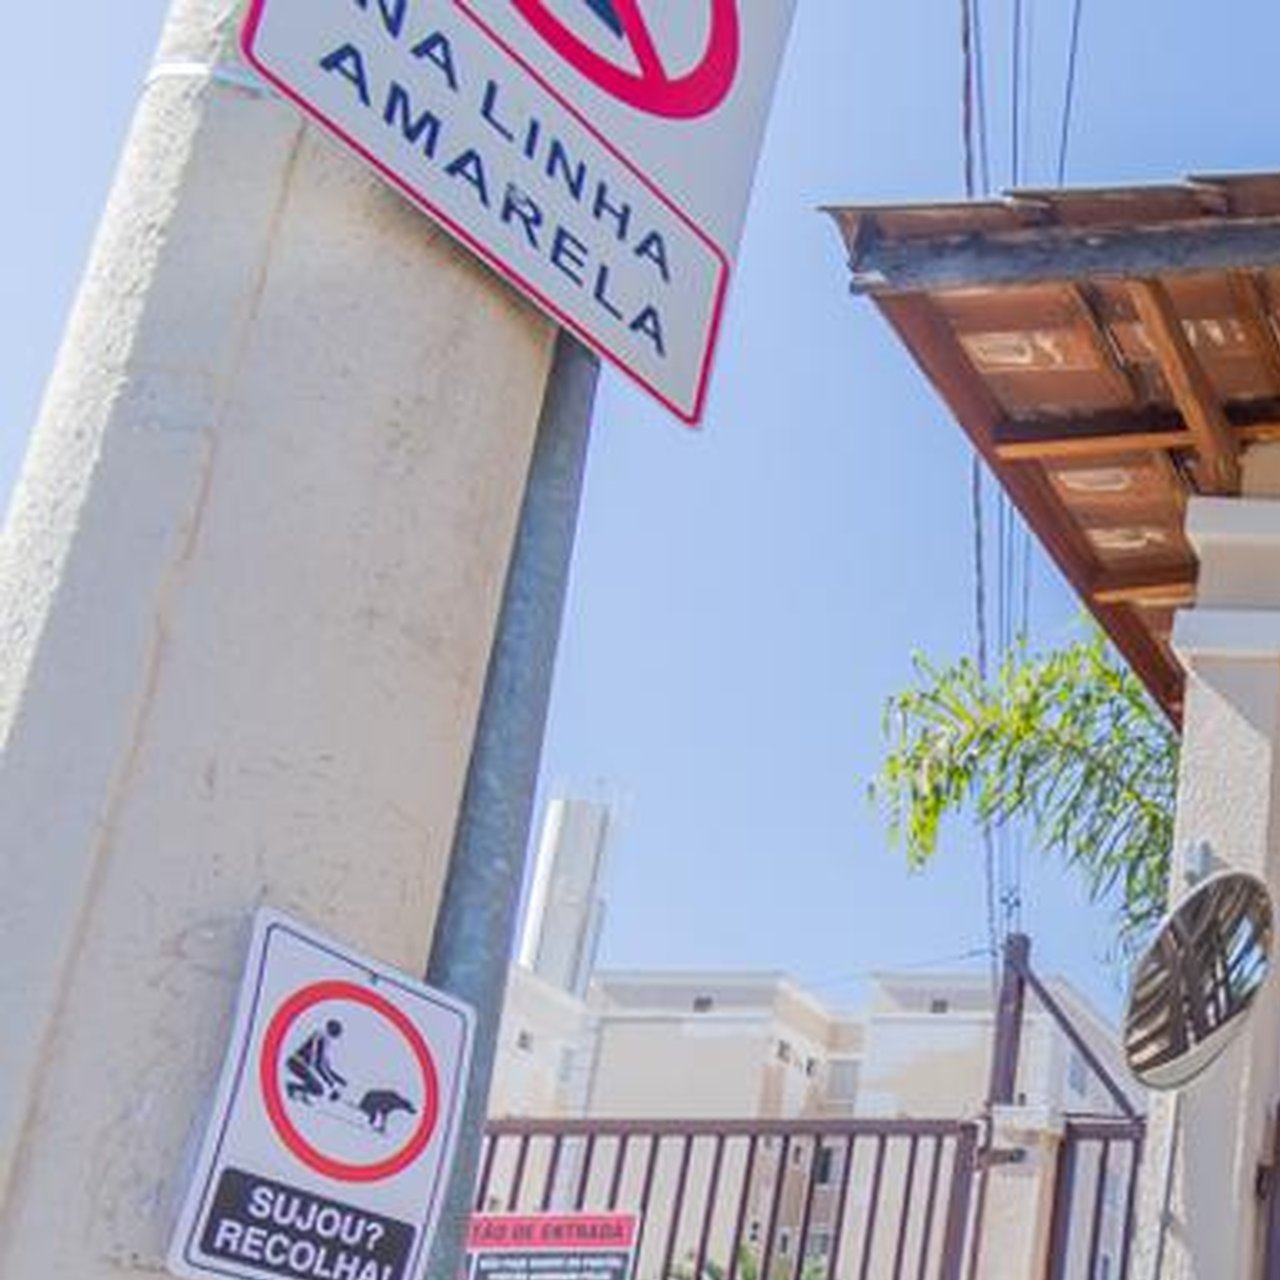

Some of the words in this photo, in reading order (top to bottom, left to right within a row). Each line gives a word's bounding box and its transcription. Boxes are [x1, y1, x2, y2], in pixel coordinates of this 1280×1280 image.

[320, 43, 666, 357] AMARELA
[480, 80, 671, 284] LINHA
[248, 1185, 384, 1251] SUJOU?
[541, 1220, 624, 1240] ENTRADA
